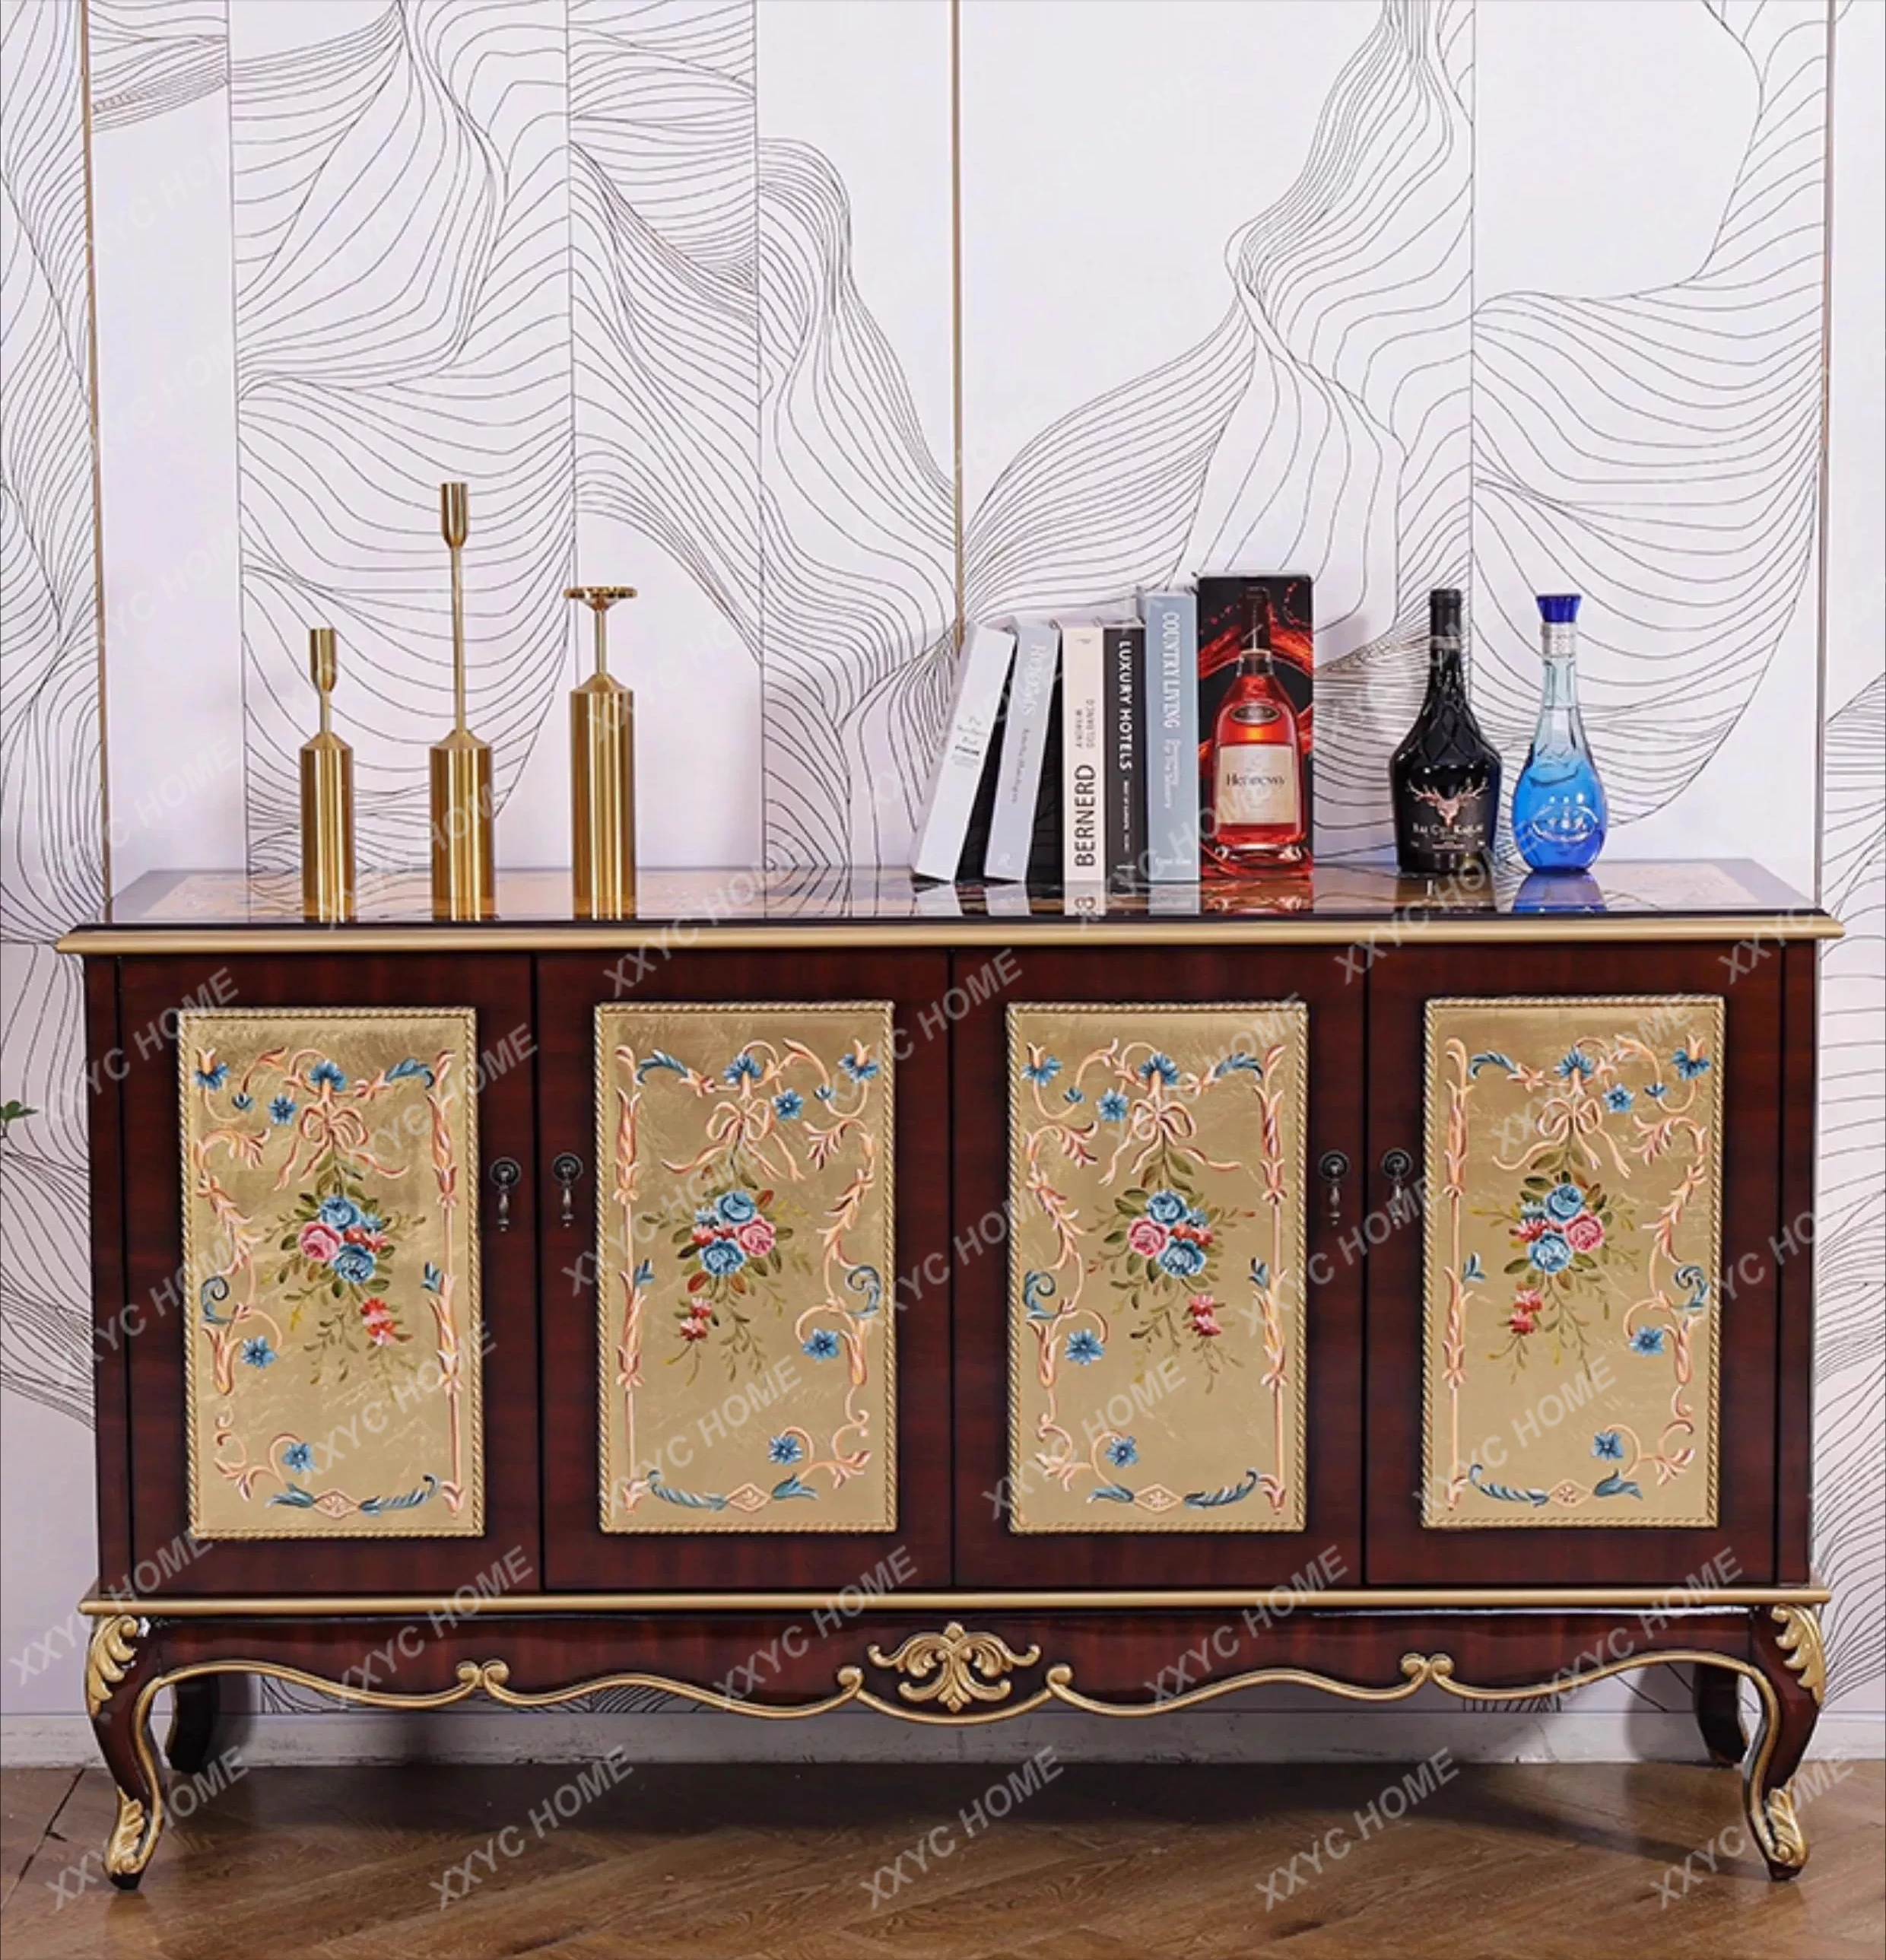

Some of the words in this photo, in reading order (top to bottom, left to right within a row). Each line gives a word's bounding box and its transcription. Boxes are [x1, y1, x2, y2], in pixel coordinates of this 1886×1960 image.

[1119, 640, 1132, 704] LUXURY
[1162, 612, 1180, 679] COUNTRY
[1162, 680, 1180, 728] LIVING
[1119, 708, 1133, 771] HOTELS
[1074, 764, 1096, 867] BERNERD
